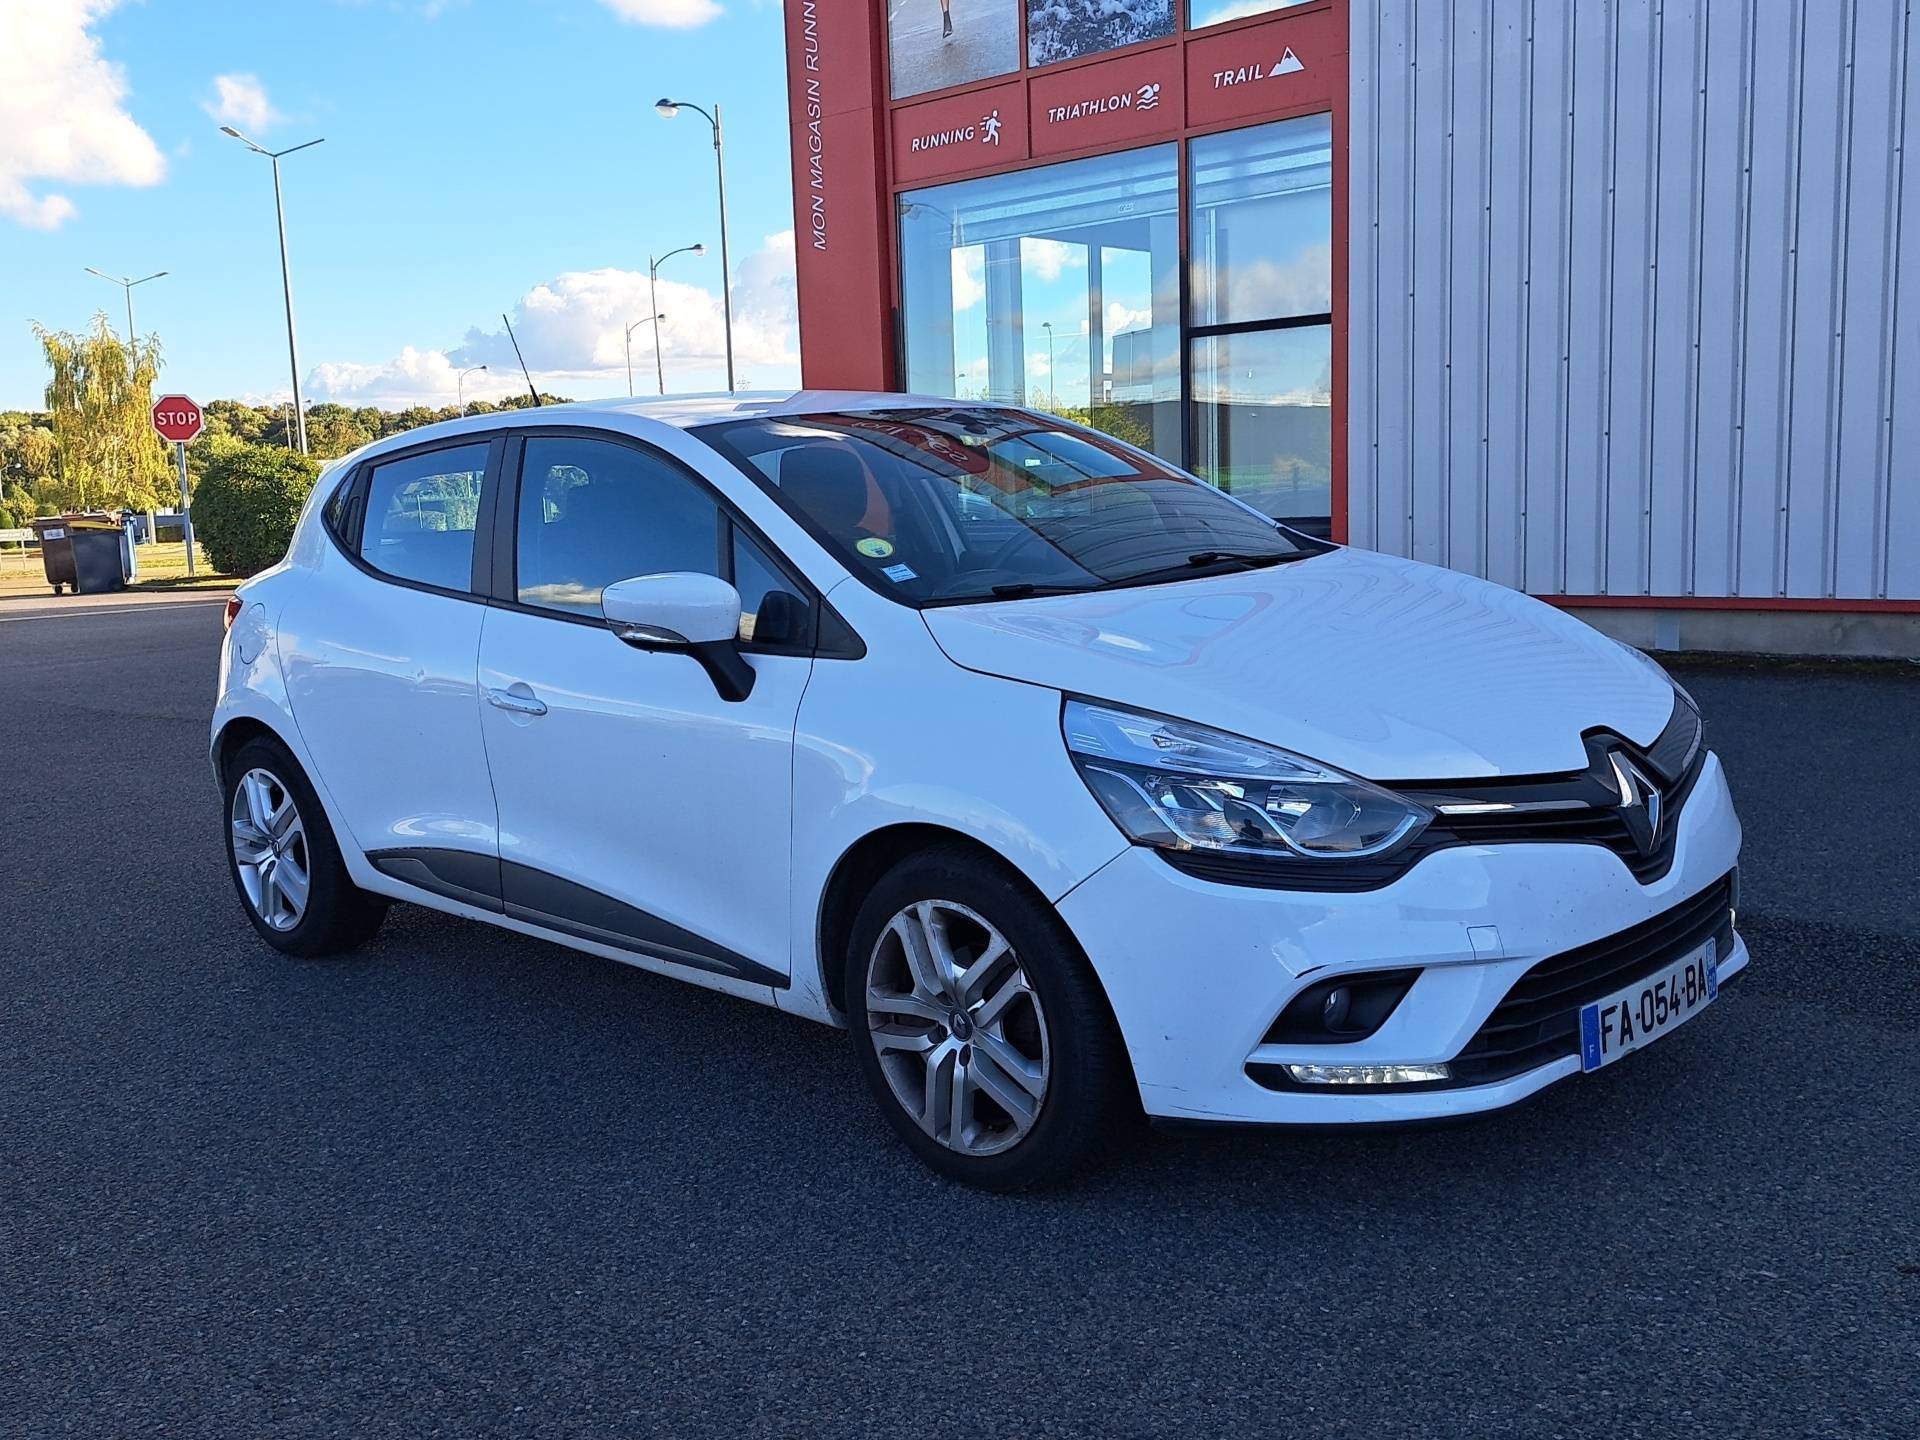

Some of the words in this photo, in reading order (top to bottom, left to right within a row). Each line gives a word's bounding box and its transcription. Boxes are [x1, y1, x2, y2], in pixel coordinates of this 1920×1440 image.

[1213, 63, 1264, 89] TRAIL
[1048, 94, 1132, 123] TRIATHLON
[807, 78, 824, 189] MAGASIN
[911, 126, 976, 153] RUNNING
[812, 195, 827, 251] MON
[157, 411, 198, 426] STOP
[1600, 957, 1708, 1055] FA-054-BA
